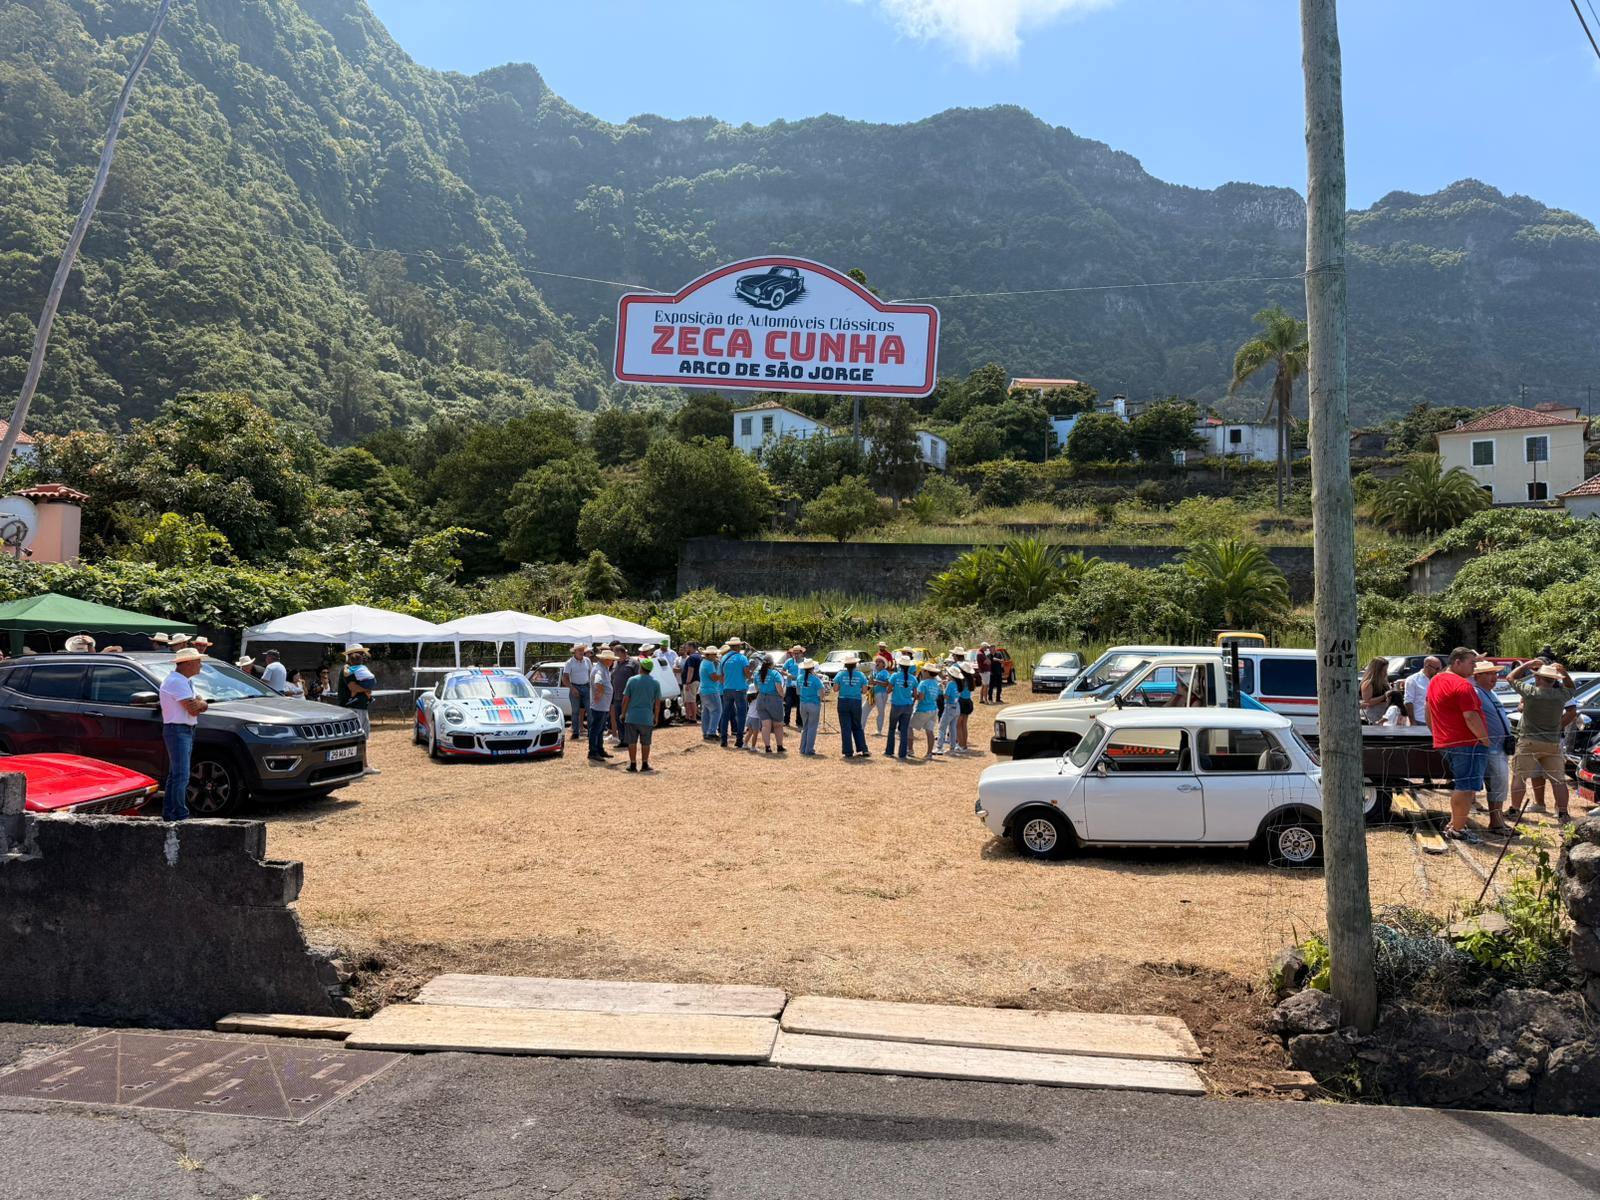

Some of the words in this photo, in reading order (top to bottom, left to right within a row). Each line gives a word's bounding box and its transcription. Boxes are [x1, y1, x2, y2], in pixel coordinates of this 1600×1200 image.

[655, 309, 722, 325] Exposição
[727, 312, 744, 325] de
[747, 313, 825, 329] Automóveis
[830, 316, 895, 331] Clássicos
[651, 325, 753, 358] ZECA
[764, 330, 905, 364] CUNHA
[679, 360, 730, 375] ARCO
[735, 363, 760, 377] DE
[765, 362, 803, 379] SÃO
[808, 366, 874, 381] JORGE
